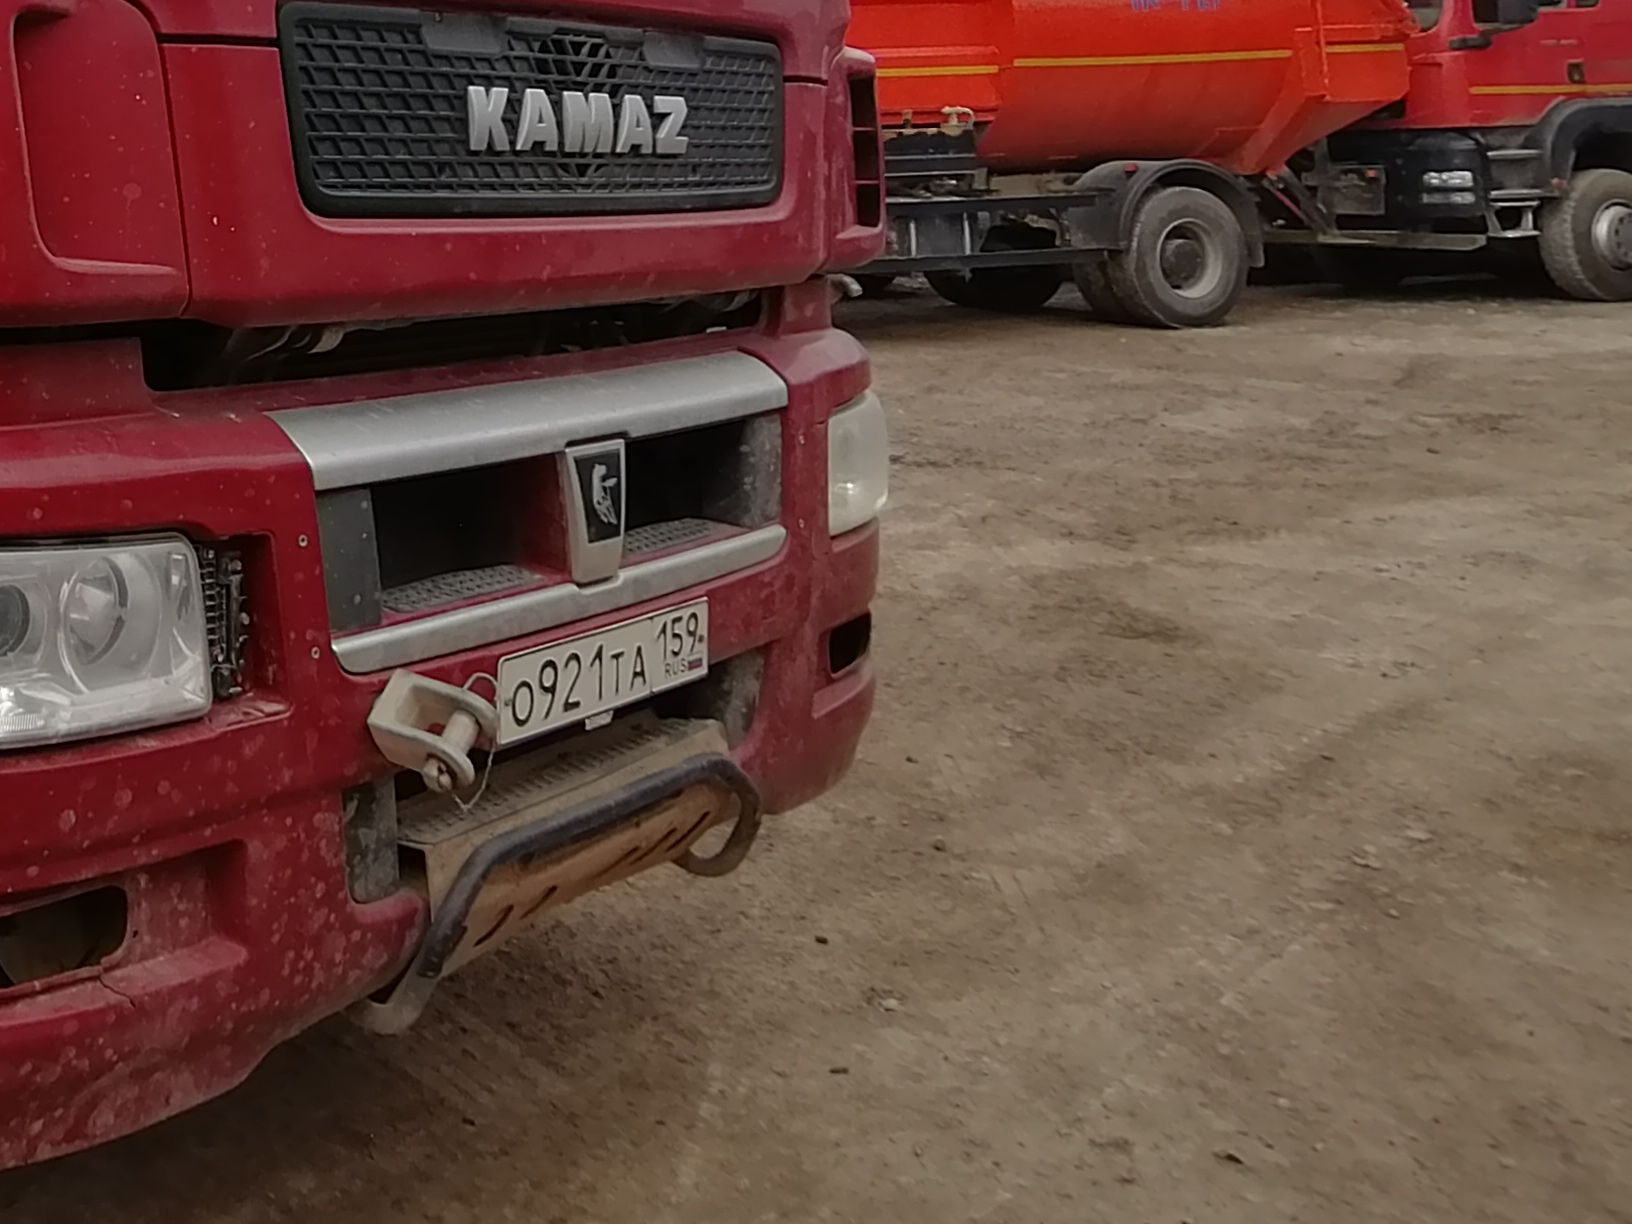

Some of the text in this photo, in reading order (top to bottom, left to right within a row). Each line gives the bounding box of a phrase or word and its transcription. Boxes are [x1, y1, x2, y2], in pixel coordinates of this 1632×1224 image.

[468, 85, 689, 155] KAMAZ
[657, 611, 699, 664] 159
[664, 657, 688, 679] RUS
